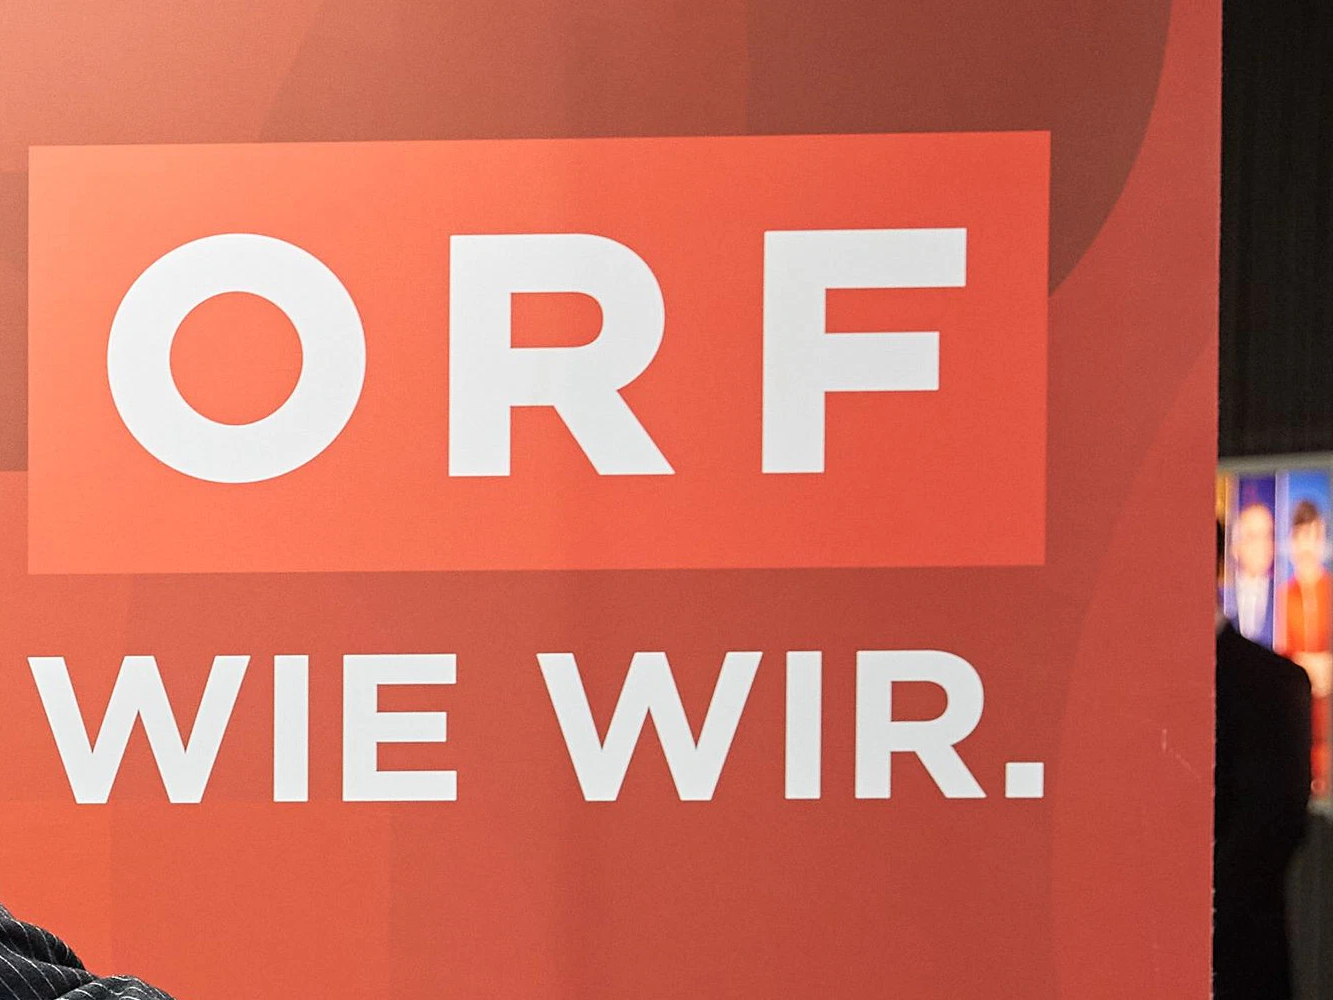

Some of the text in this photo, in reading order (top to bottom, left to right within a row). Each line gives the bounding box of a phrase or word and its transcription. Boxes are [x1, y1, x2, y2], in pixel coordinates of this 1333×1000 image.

[106, 227, 968, 484] ORF
[27, 649, 1045, 805] WIE WIR.
